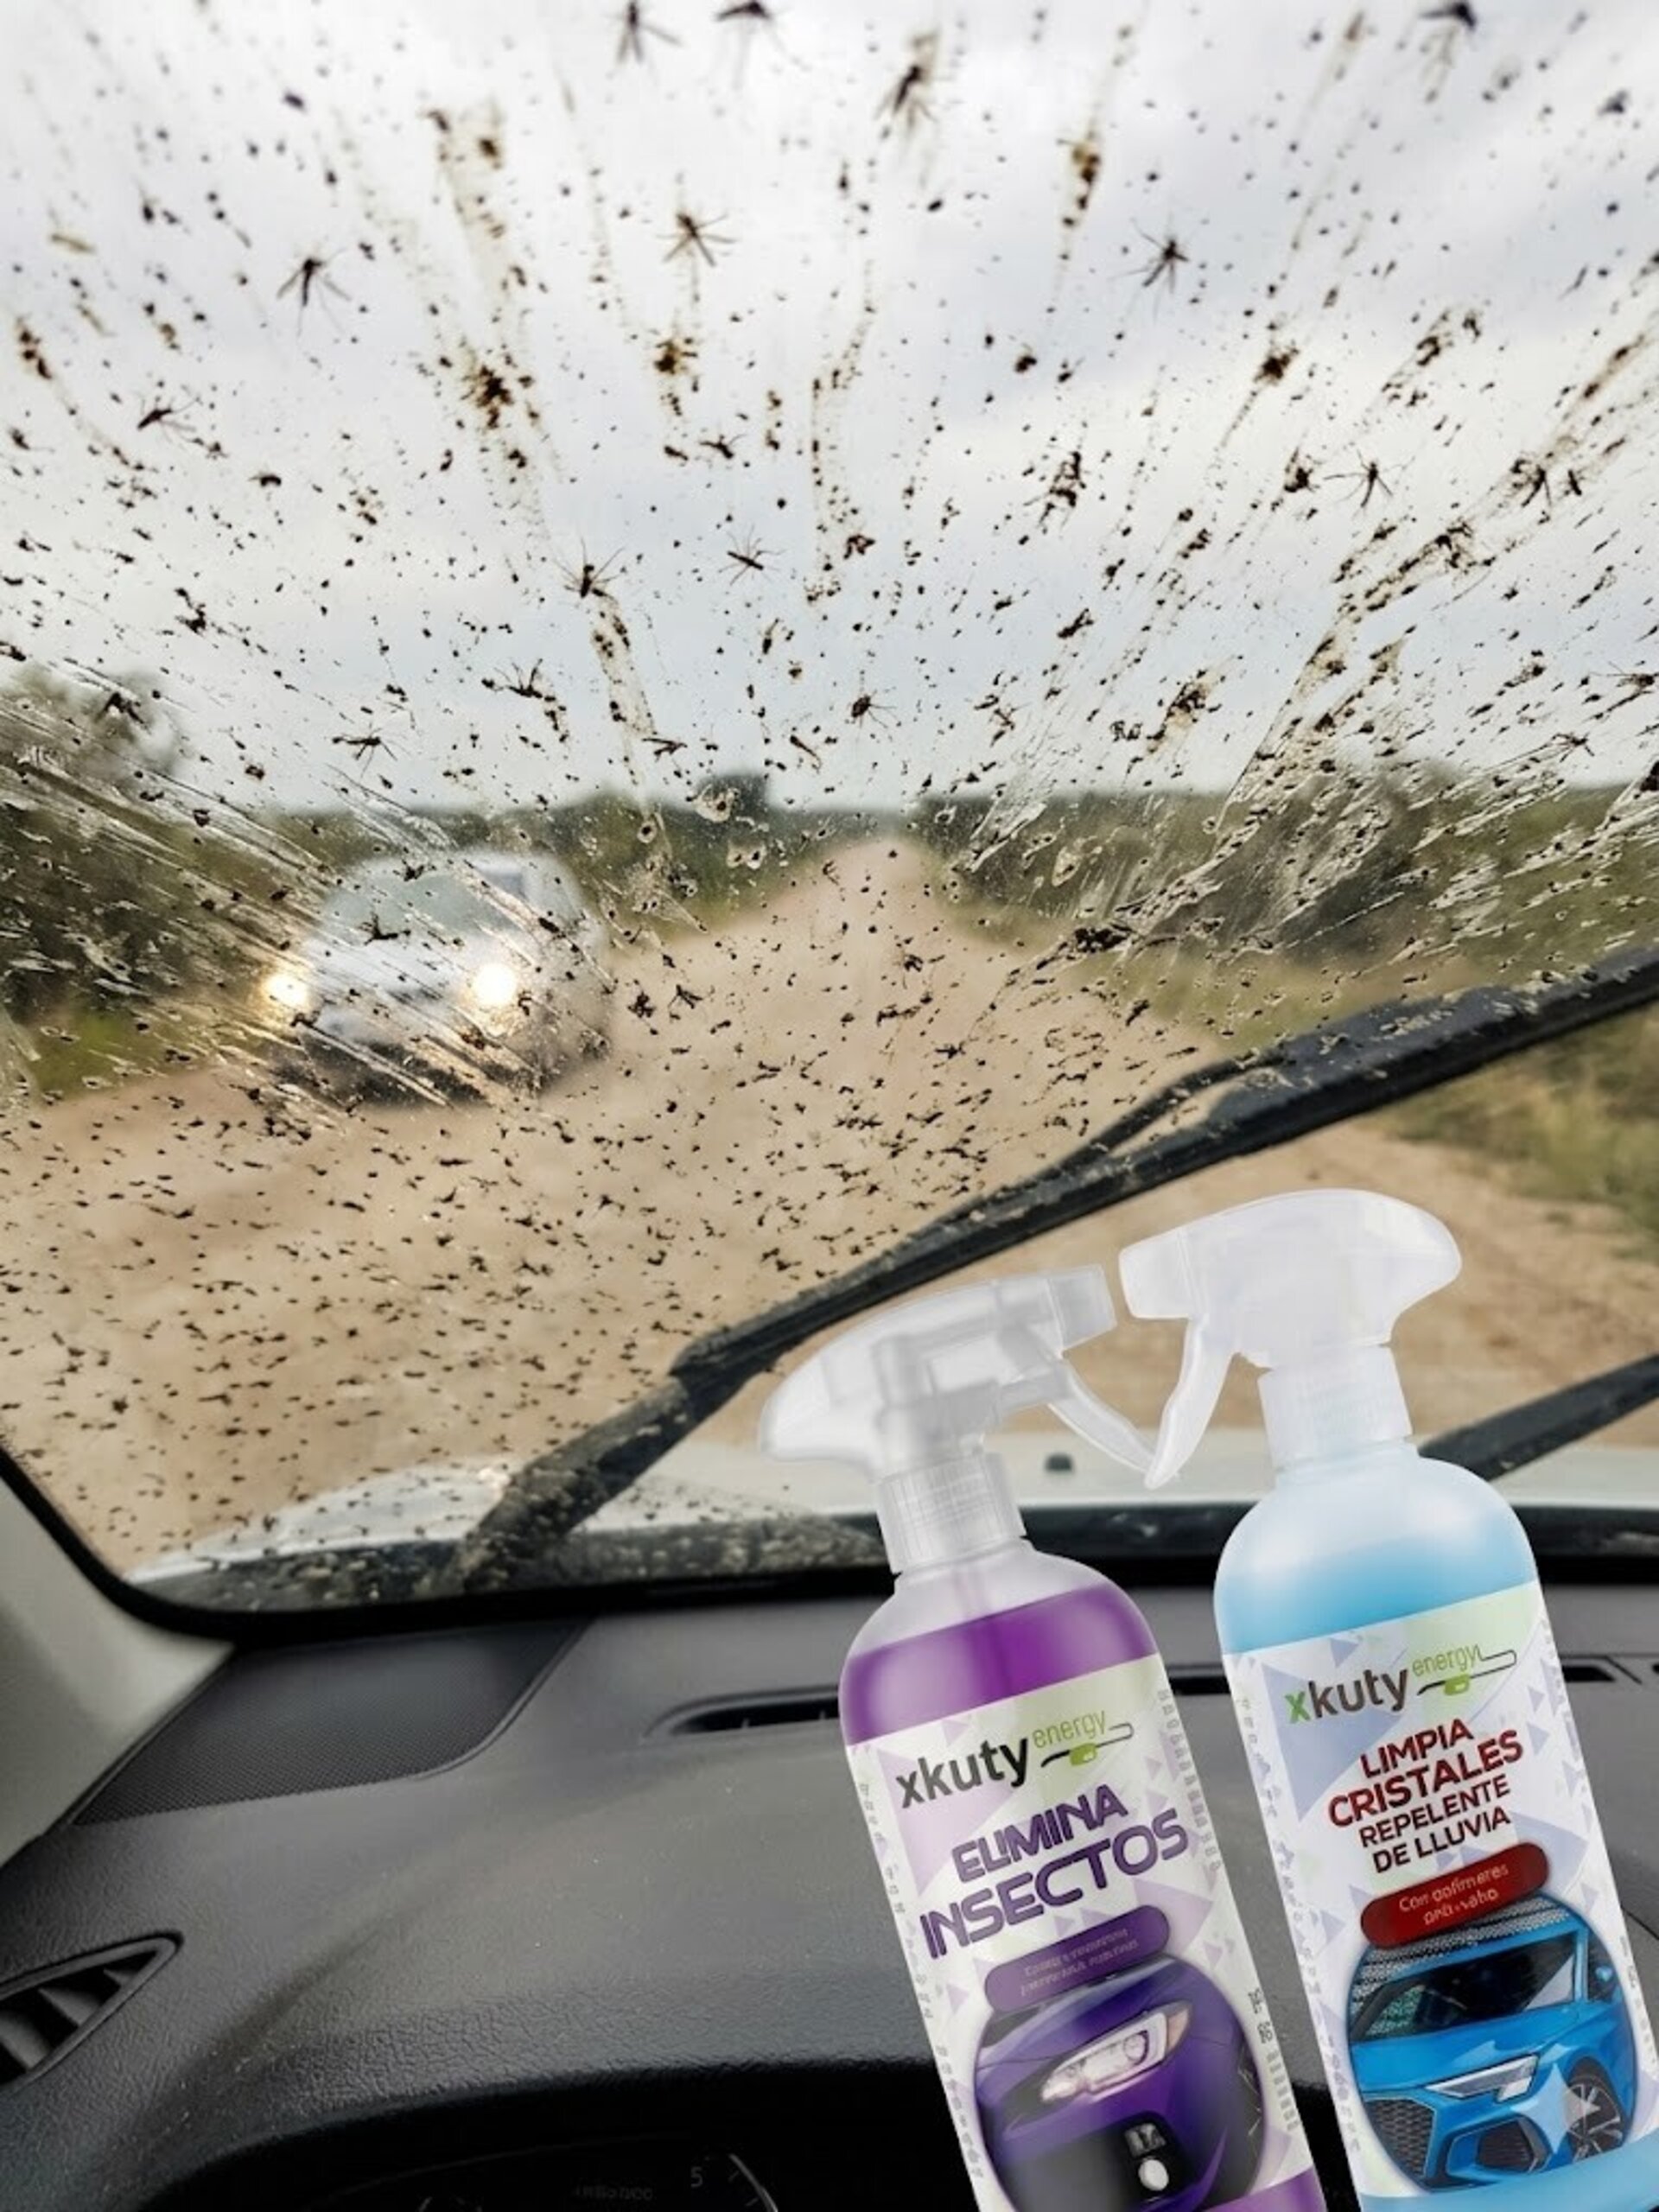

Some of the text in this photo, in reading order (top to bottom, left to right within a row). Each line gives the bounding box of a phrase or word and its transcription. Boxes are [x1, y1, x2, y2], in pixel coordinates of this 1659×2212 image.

[1285, 1643, 1482, 1724] xkuty energy
[896, 1710, 1107, 1808] xkuty energy
[1328, 1729, 1523, 1827] CRISTALES
[1362, 1718, 1474, 1780] LIMPIA
[951, 1783, 1129, 1883] ELIMINA
[1360, 1774, 1510, 1848] REPELENTE
[1374, 1806, 1511, 1873] DE LLUVIA
[919, 1807, 1189, 1960] INSECTOS
